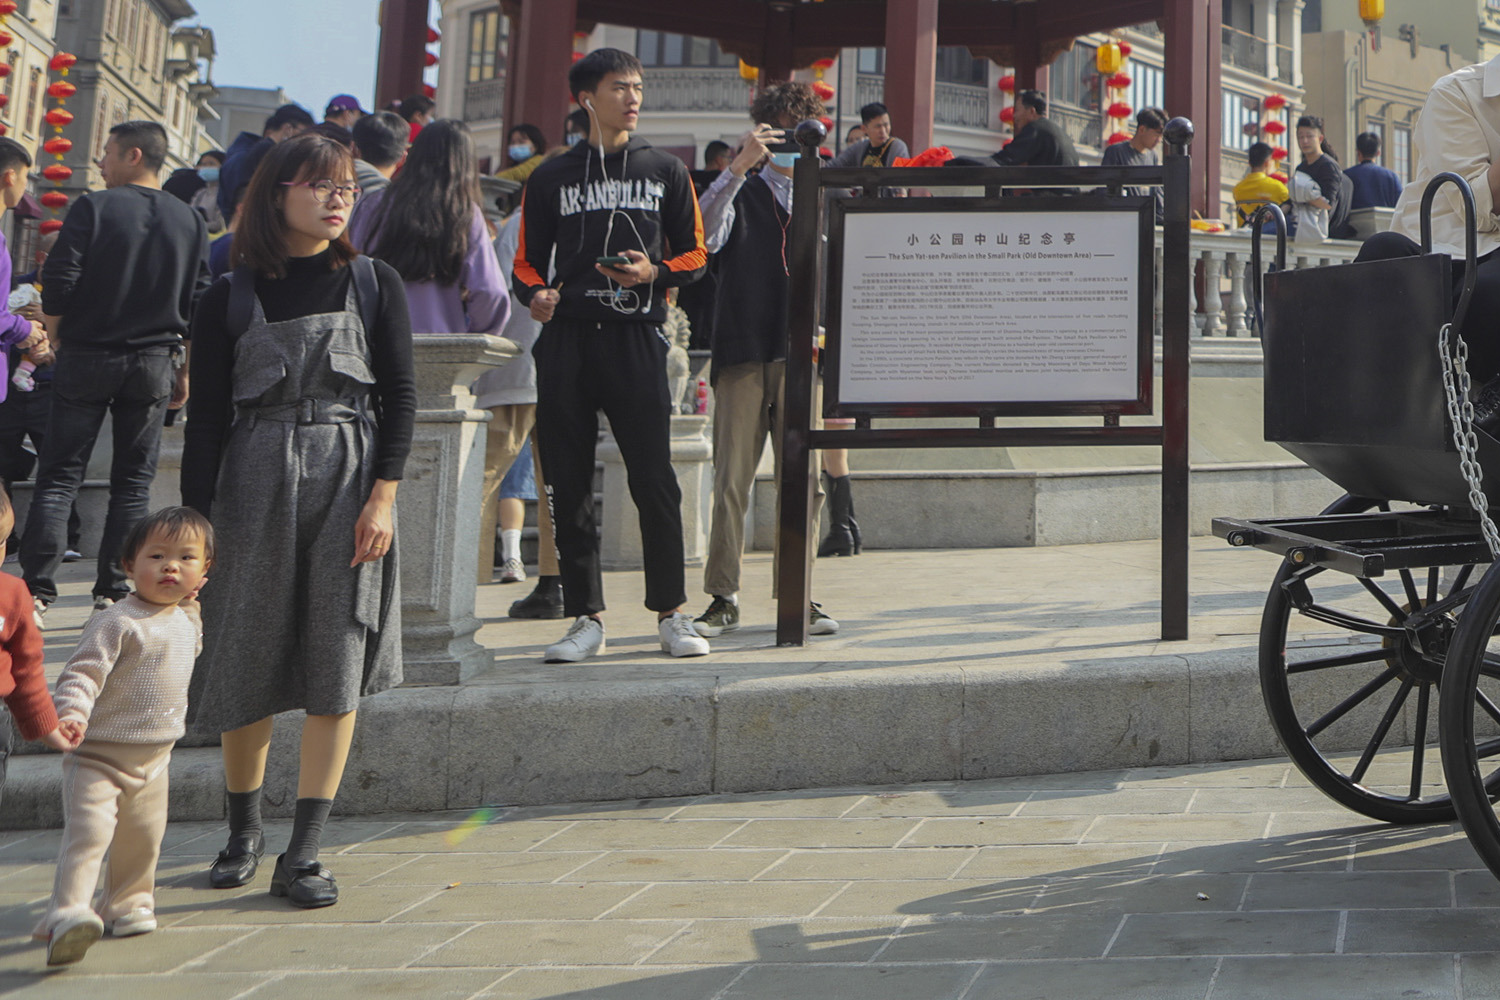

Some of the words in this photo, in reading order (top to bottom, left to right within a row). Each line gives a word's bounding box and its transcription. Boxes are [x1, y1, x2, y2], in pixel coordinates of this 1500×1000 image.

[907, 232, 1076, 246] 小公园中山纪念亭
[968, 252, 974, 260] in
[976, 252, 986, 260] the
[988, 252, 1006, 260] Small
